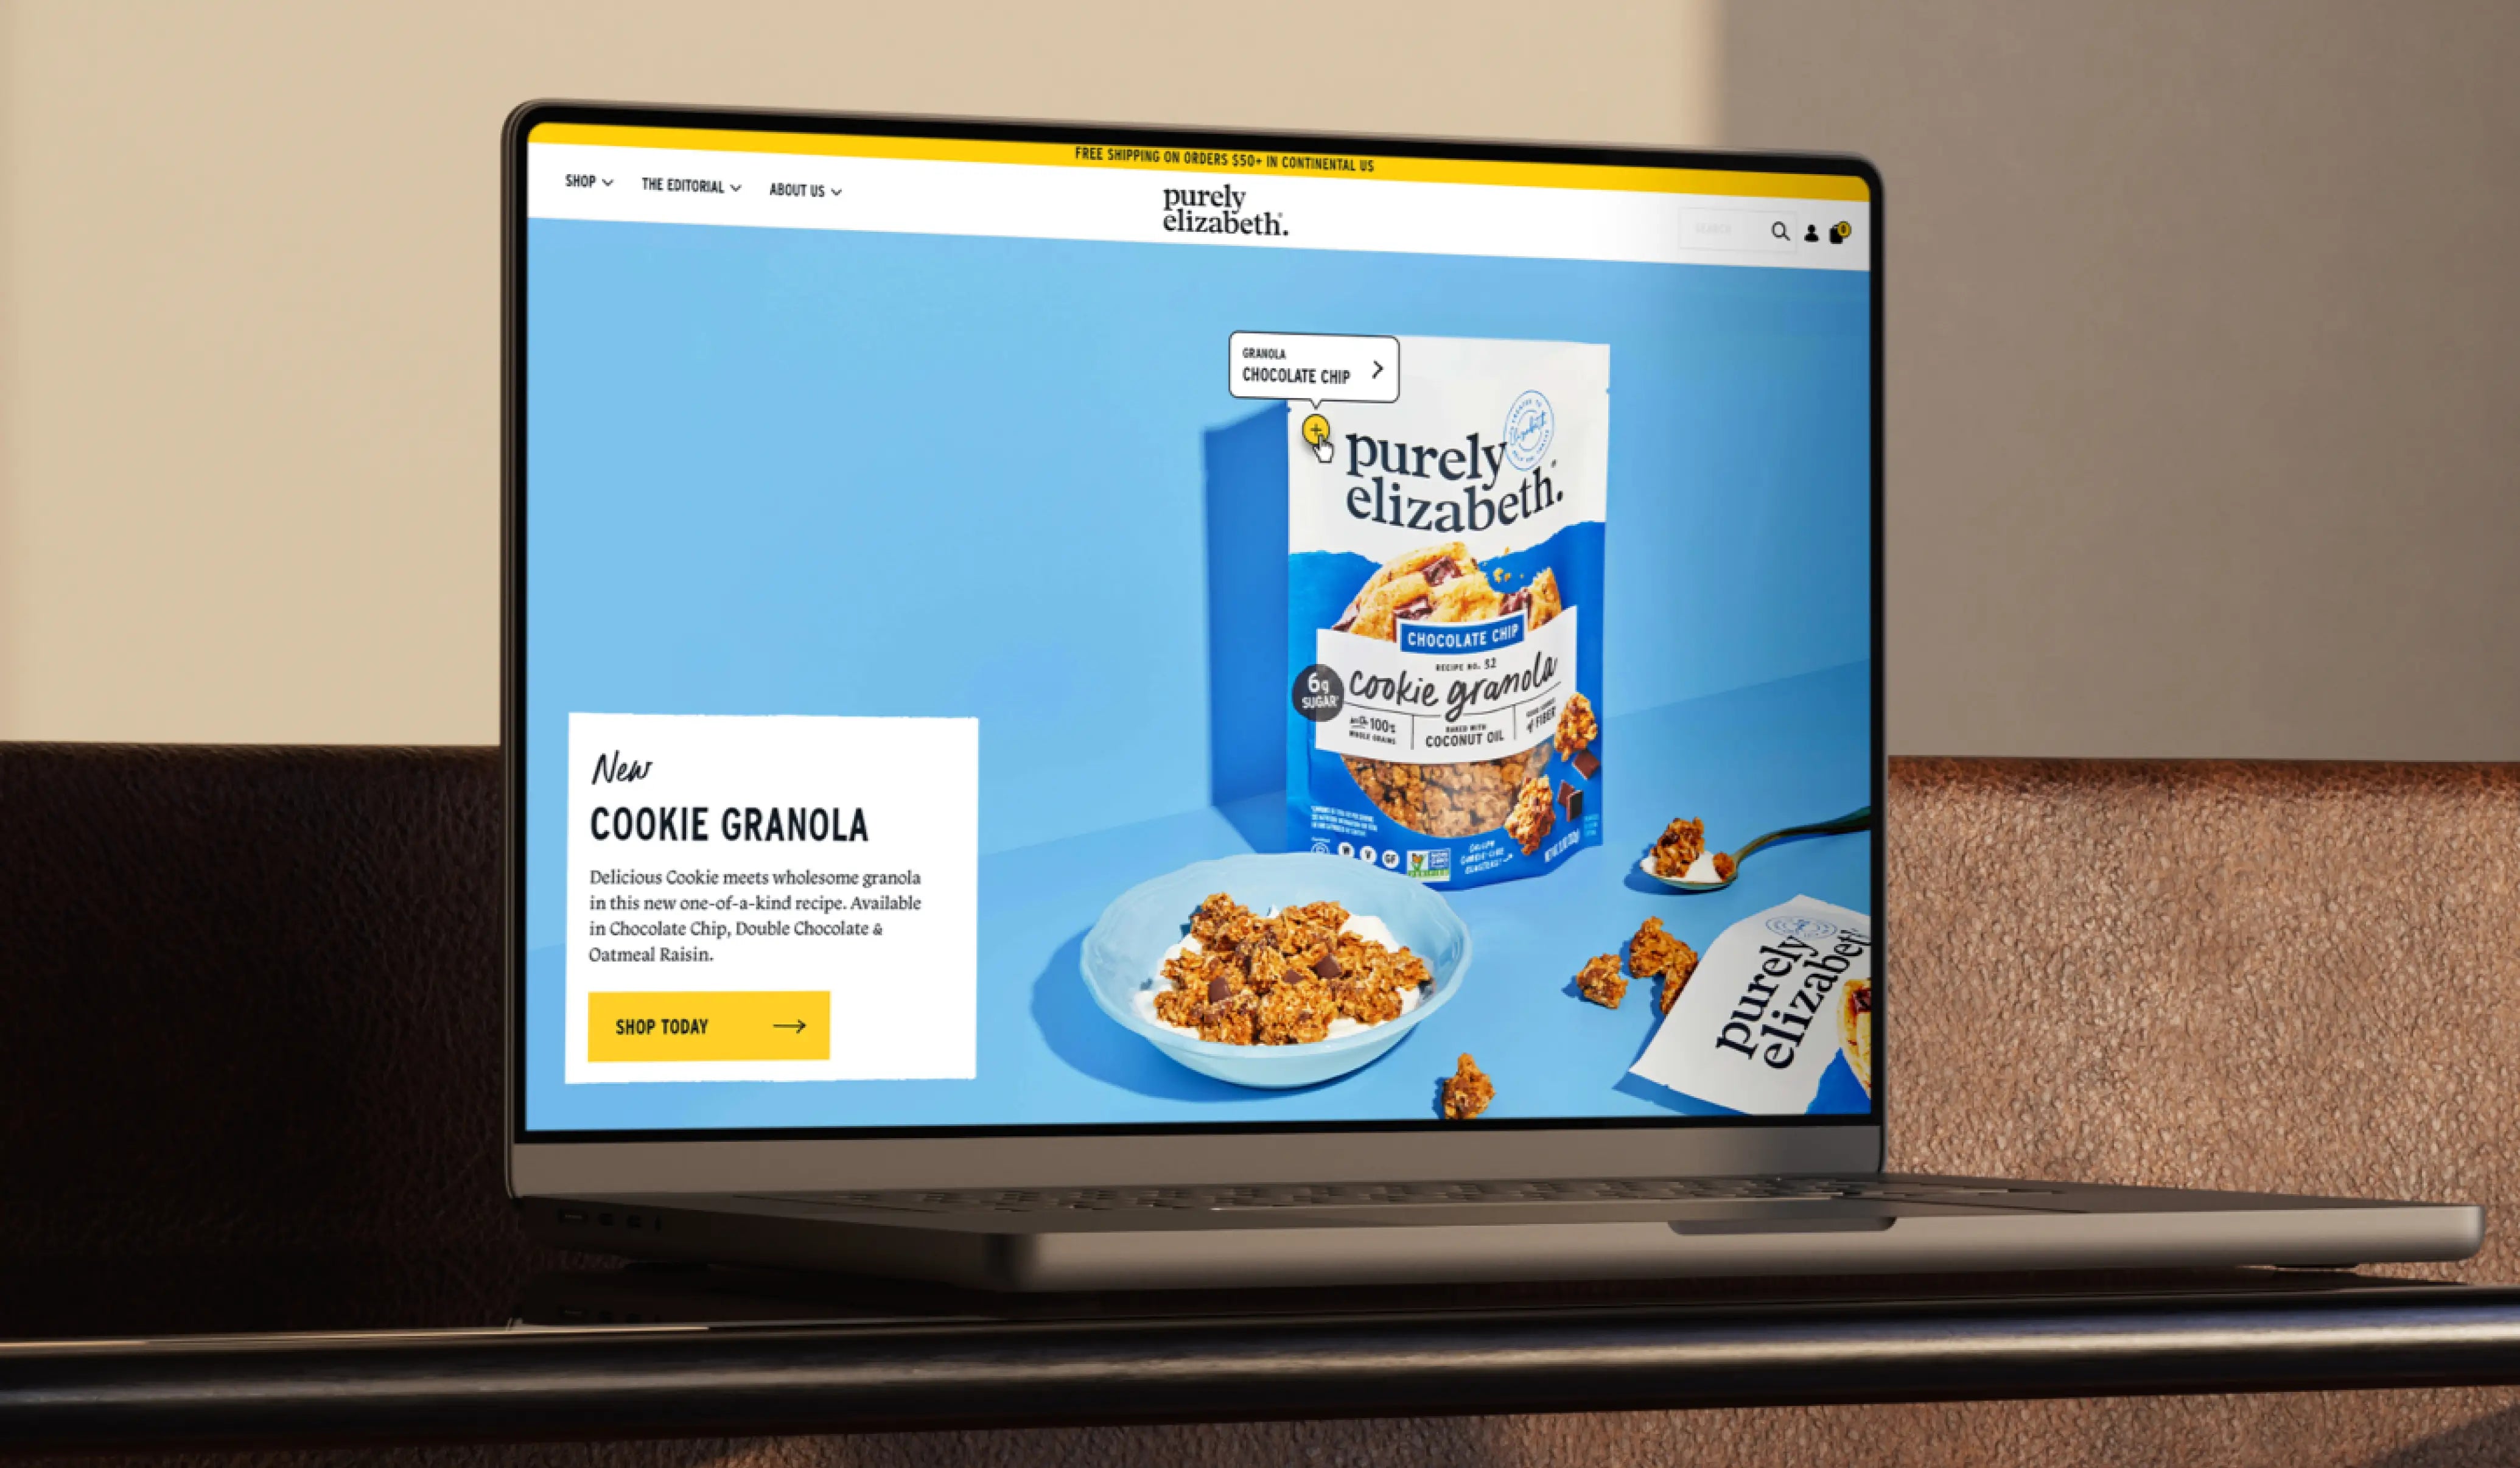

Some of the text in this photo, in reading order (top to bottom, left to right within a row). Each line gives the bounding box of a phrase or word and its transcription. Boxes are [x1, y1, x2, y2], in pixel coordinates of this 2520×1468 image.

[1076, 147, 1374, 172] FREE SHIPPING ON ORDERS $50+ IN CONTINENTAL US
[565, 174, 597, 188] SHOP
[642, 177, 725, 194] THE EDITORIAL
[770, 183, 825, 198] ABOUT US
[1163, 183, 1246, 214] purely
[1163, 208, 1290, 237] elizabeth.
[1242, 347, 1286, 360] GRANOLA
[1242, 366, 1351, 385] CHOCOLATE CHIP
[1345, 432, 1507, 489] purely
[1346, 466, 1564, 533] elizabeth.
[1407, 623, 1520, 648] CHOCOLATE CHIP
[1307, 672, 1329, 694] 6g
[1349, 651, 1558, 722] cookie granola
[1426, 730, 1504, 747] COCONUT OIL
[591, 750, 653, 785] New
[590, 806, 869, 842] COOKIE GRANOLA
[590, 869, 921, 889] Delicious Cookie meets wholesome granola
[590, 895, 921, 915] in this new one-of-a-kind recipe. Available
[590, 920, 883, 940] in Chocolate Chip, Double Chocolate &
[589, 946, 714, 962] Oatmeal Raisin.
[1715, 935, 1819, 1060] purely
[616, 1018, 709, 1035] SHOP TODAY
